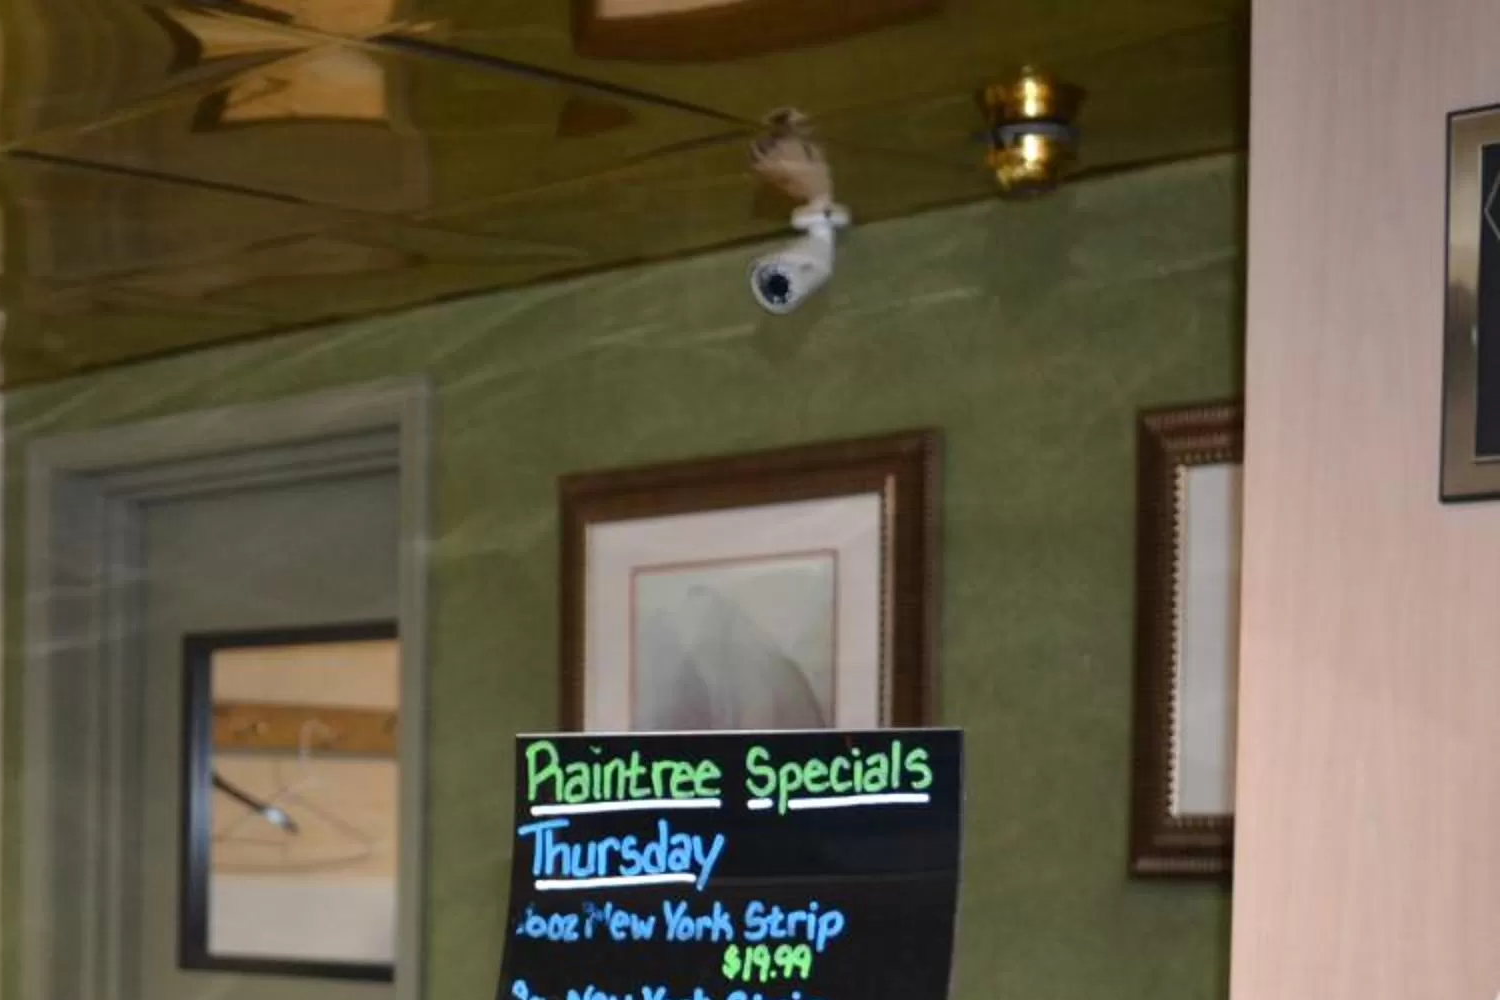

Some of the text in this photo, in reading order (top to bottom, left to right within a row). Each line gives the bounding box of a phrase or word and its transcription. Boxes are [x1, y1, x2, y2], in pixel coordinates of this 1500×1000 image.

[526, 740, 934, 814] Raintree Specials
[518, 818, 724, 890] Thursday
[515, 902, 579, 941] 6oz
[663, 900, 734, 942] York
[743, 902, 844, 952] Strip
[722, 944, 812, 981] $19.99
